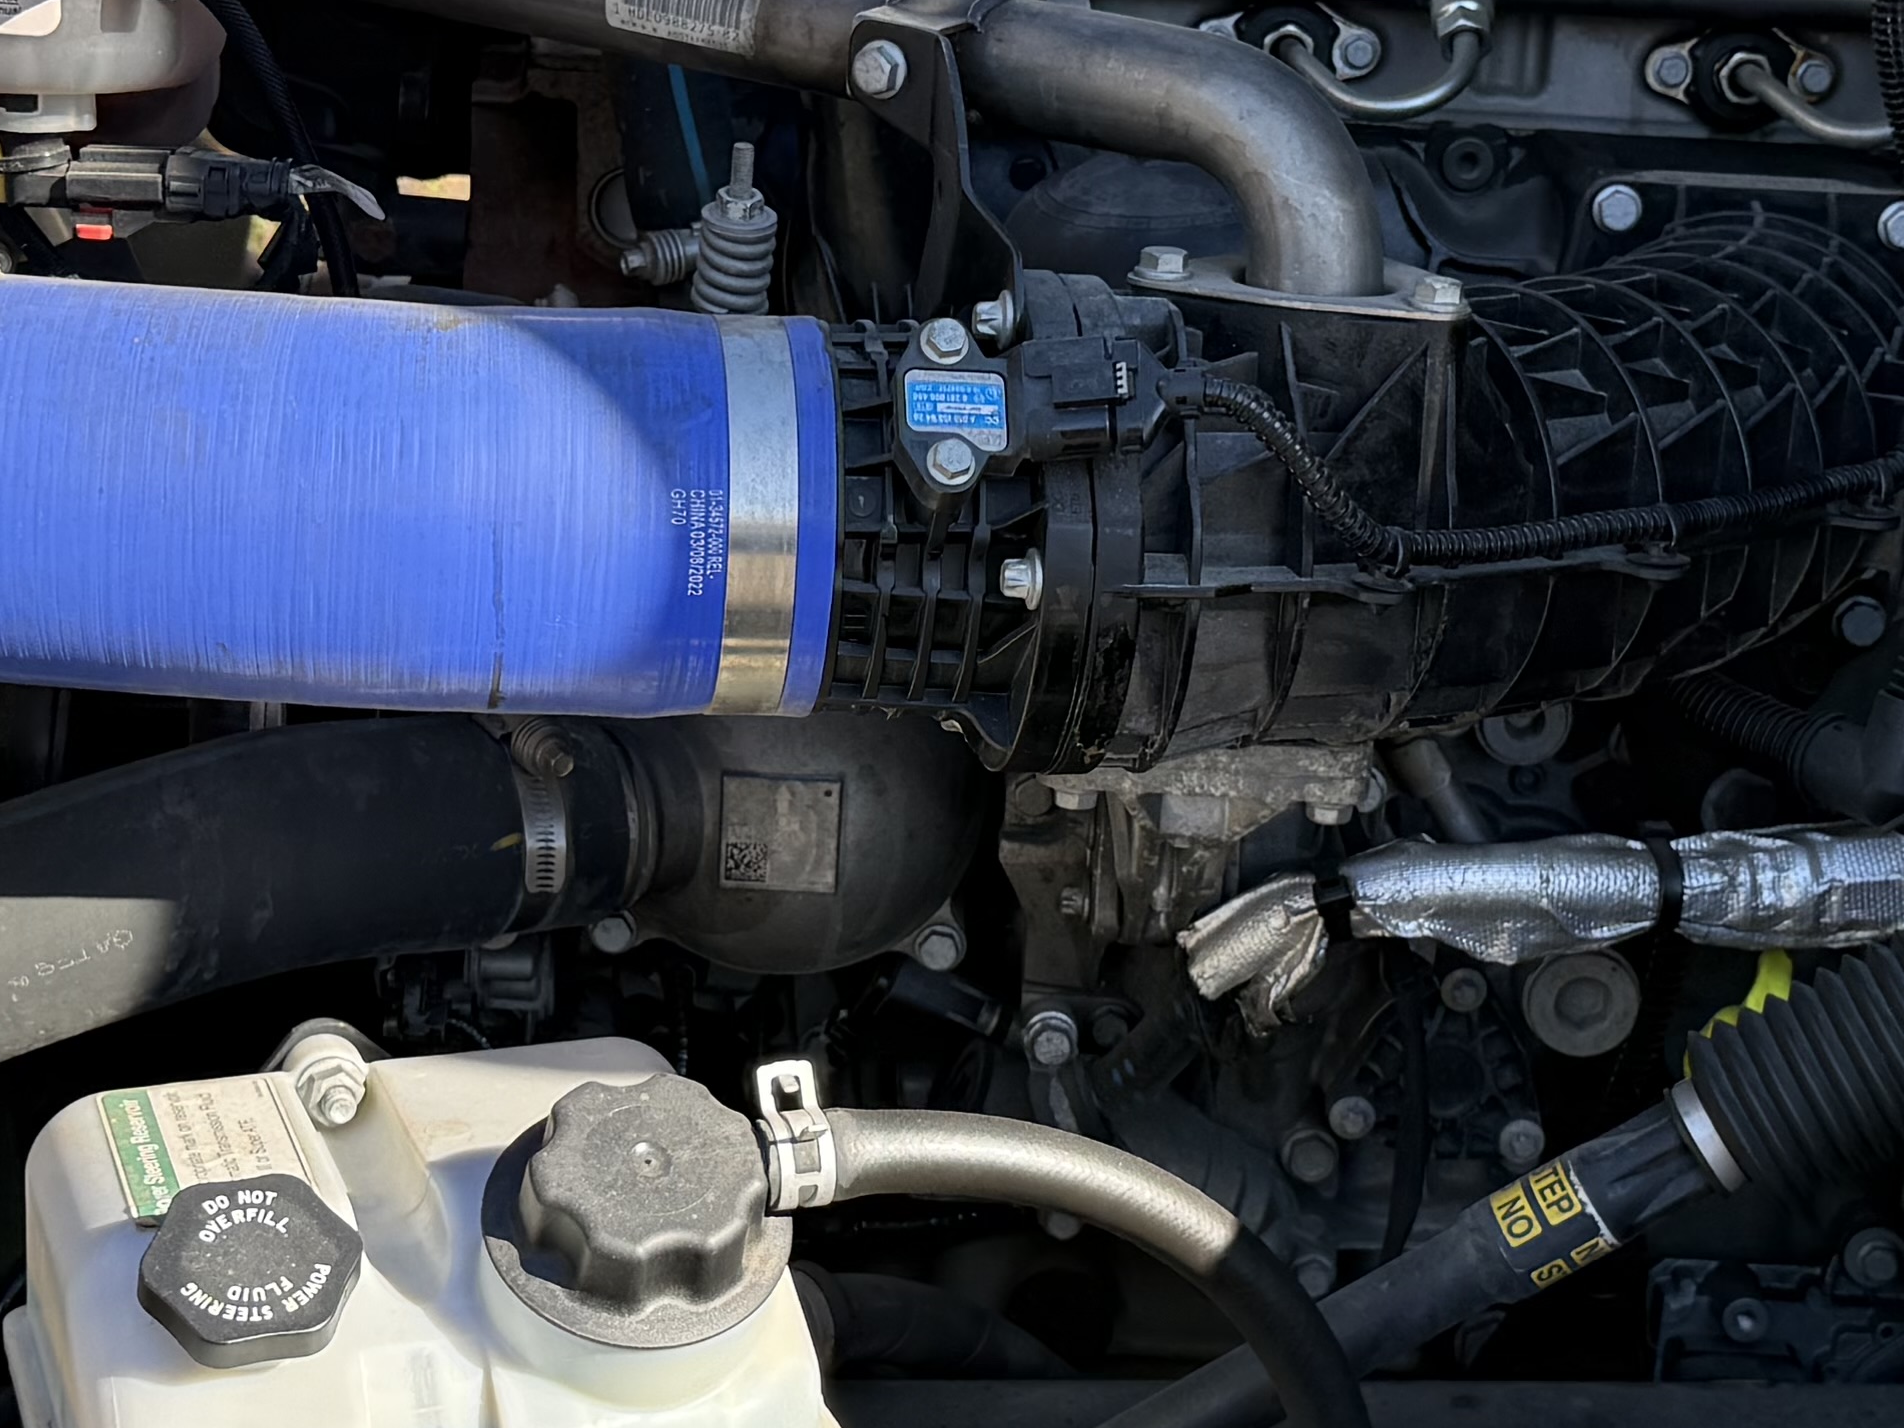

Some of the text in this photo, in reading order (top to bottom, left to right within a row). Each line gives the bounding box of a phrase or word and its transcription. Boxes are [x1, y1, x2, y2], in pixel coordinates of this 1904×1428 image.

[671, 489, 686, 525] GH70
[688, 490, 705, 596] CHINA 03/08/2022
[138, 1143, 165, 1185] Steering
[202, 1190, 277, 1215] DO NOT
[1535, 1167, 1574, 1214] TEP
[199, 1208, 289, 1242] OVERFILL
[1497, 1196, 1534, 1239] NO
[180, 1264, 331, 1321] POWER STEERING
[227, 1276, 294, 1301] FLUID
